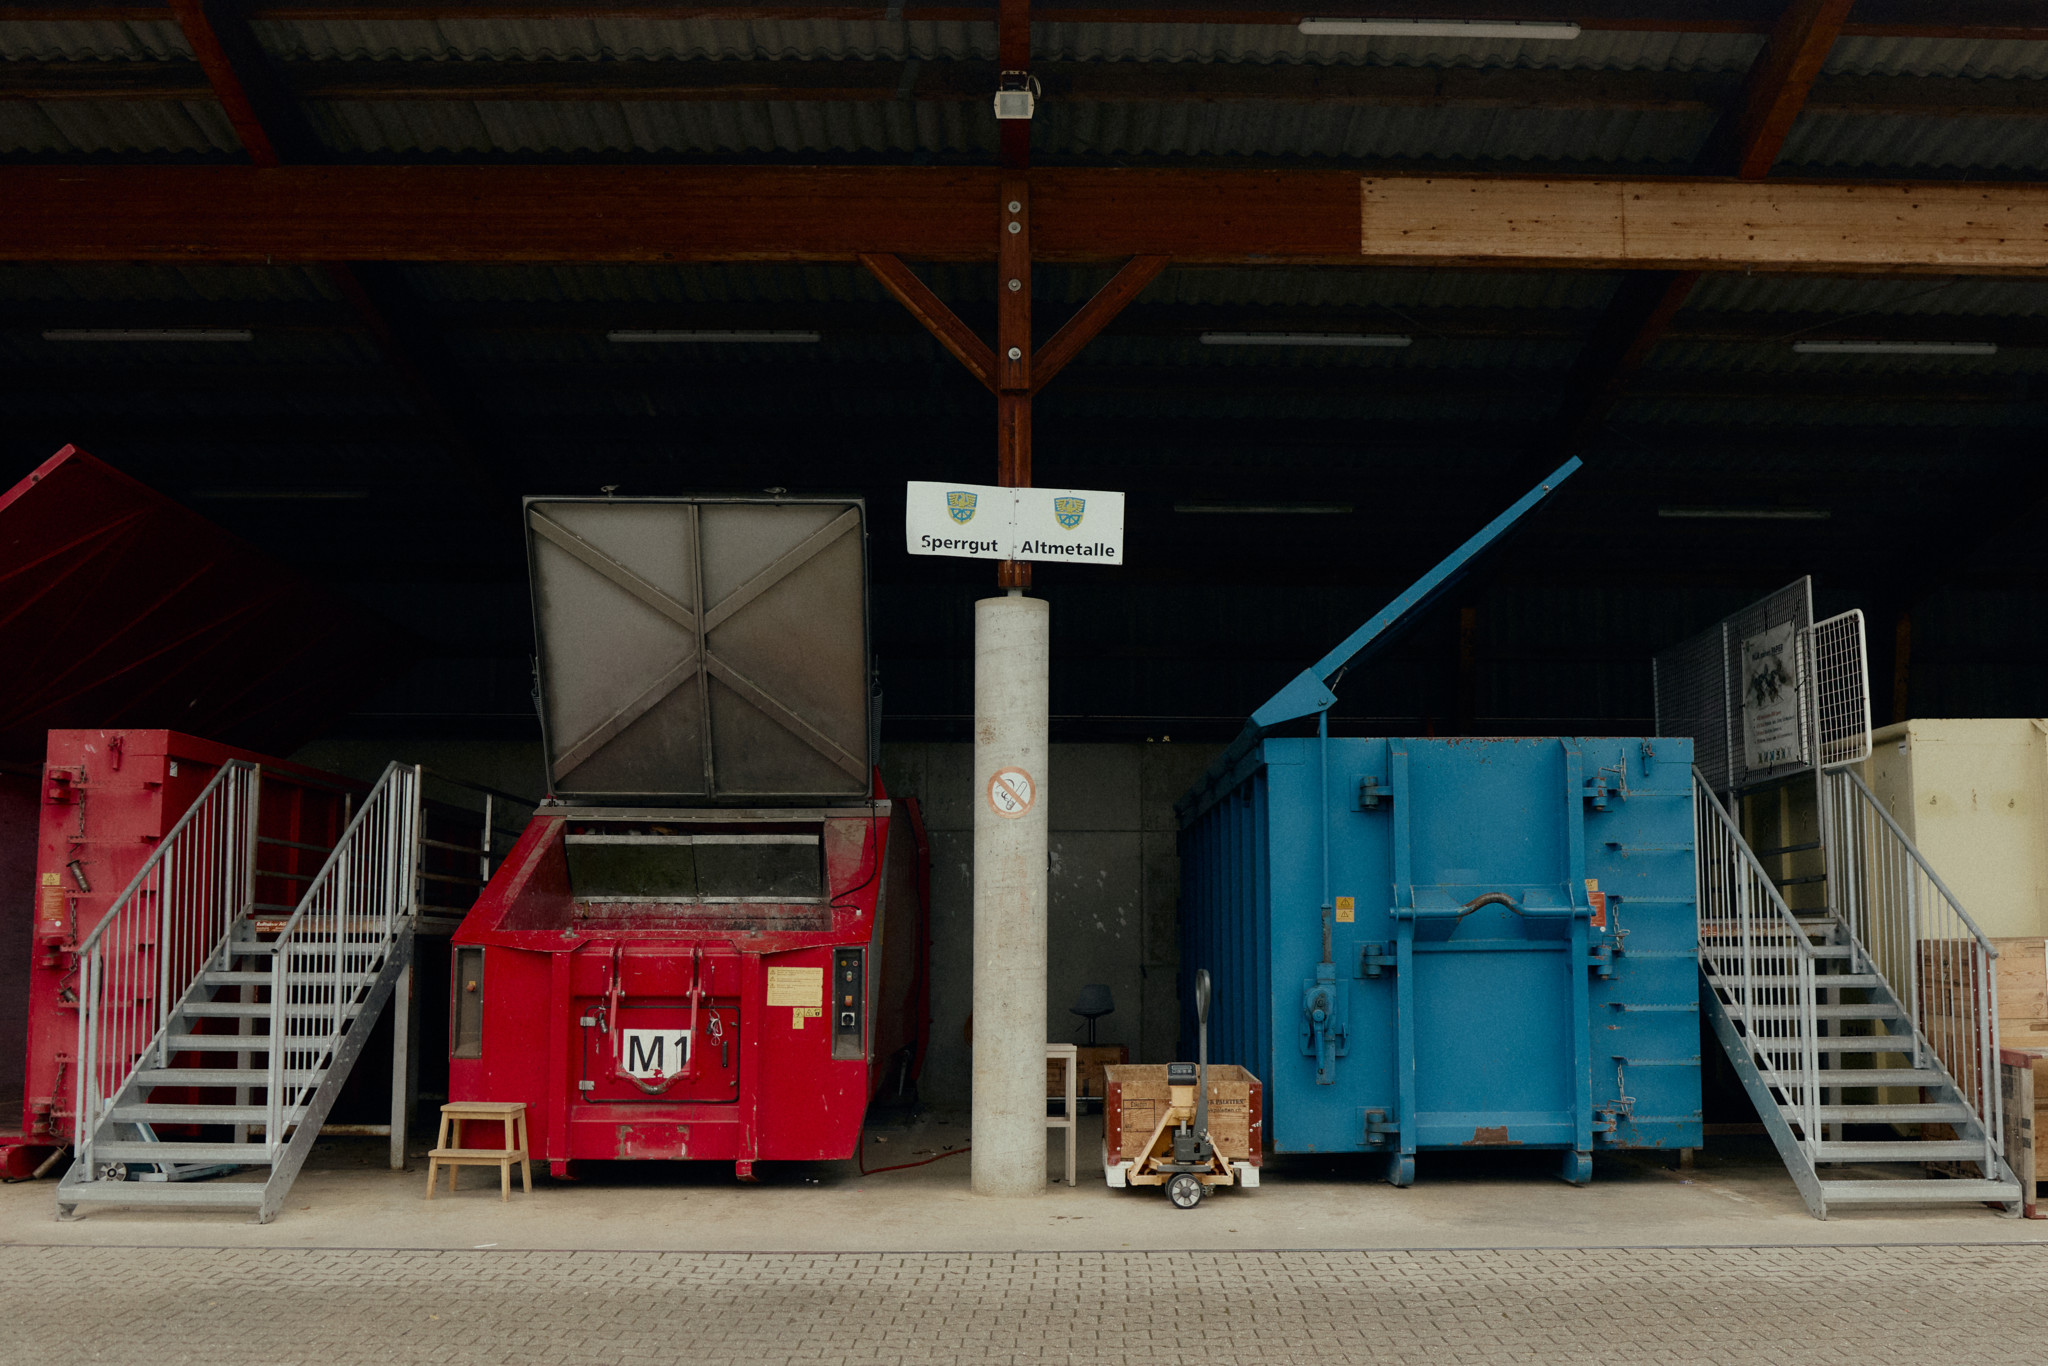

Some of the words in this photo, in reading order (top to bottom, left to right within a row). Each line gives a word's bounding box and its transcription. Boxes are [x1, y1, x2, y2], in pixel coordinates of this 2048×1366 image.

[921, 534, 998, 554] Sperrgut
[1020, 540, 1115, 557] Altmetalle
[629, 1035, 687, 1072] M1
